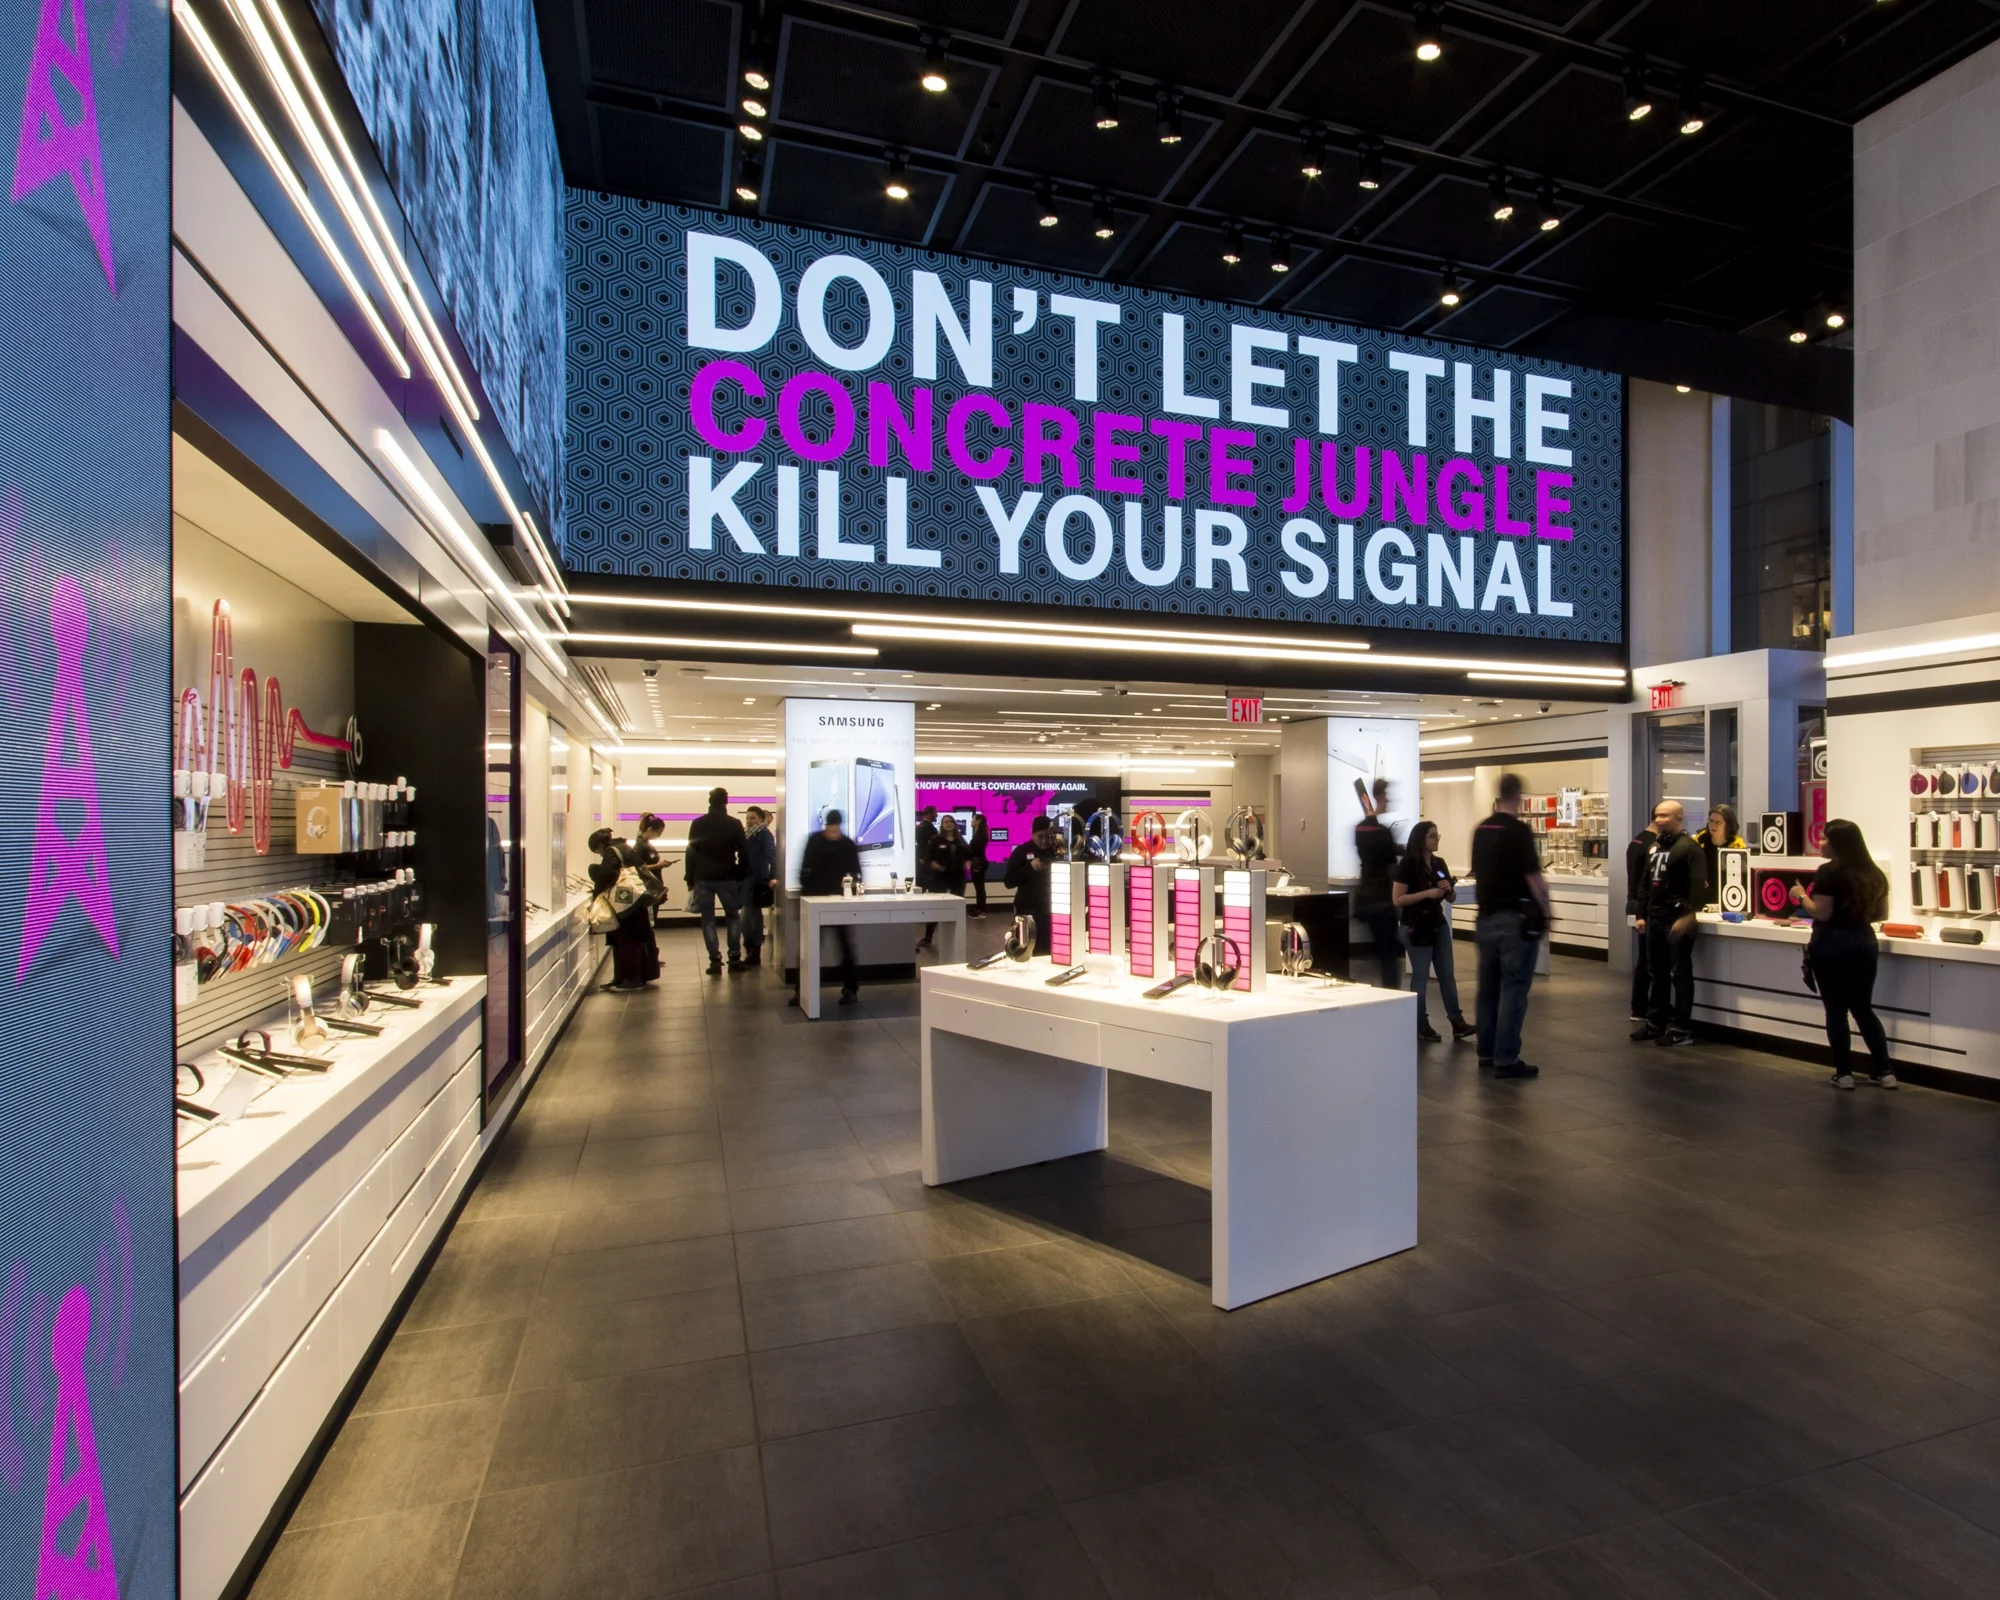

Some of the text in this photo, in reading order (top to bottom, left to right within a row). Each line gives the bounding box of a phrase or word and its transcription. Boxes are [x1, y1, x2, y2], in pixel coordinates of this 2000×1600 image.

[686, 230, 1573, 468] DON'T LET THE
[688, 358, 1574, 542] CONCRETE JUNGLE
[688, 457, 1574, 618] KILL YOUR SIGNAL
[1651, 686, 1672, 709] EXIT
[818, 715, 885, 728] SAMSUNG
[1231, 698, 1260, 722] EXIT
[915, 781, 1088, 791] KNOW T-MOBILE'S COVERAGE? THINK AGAIN.
